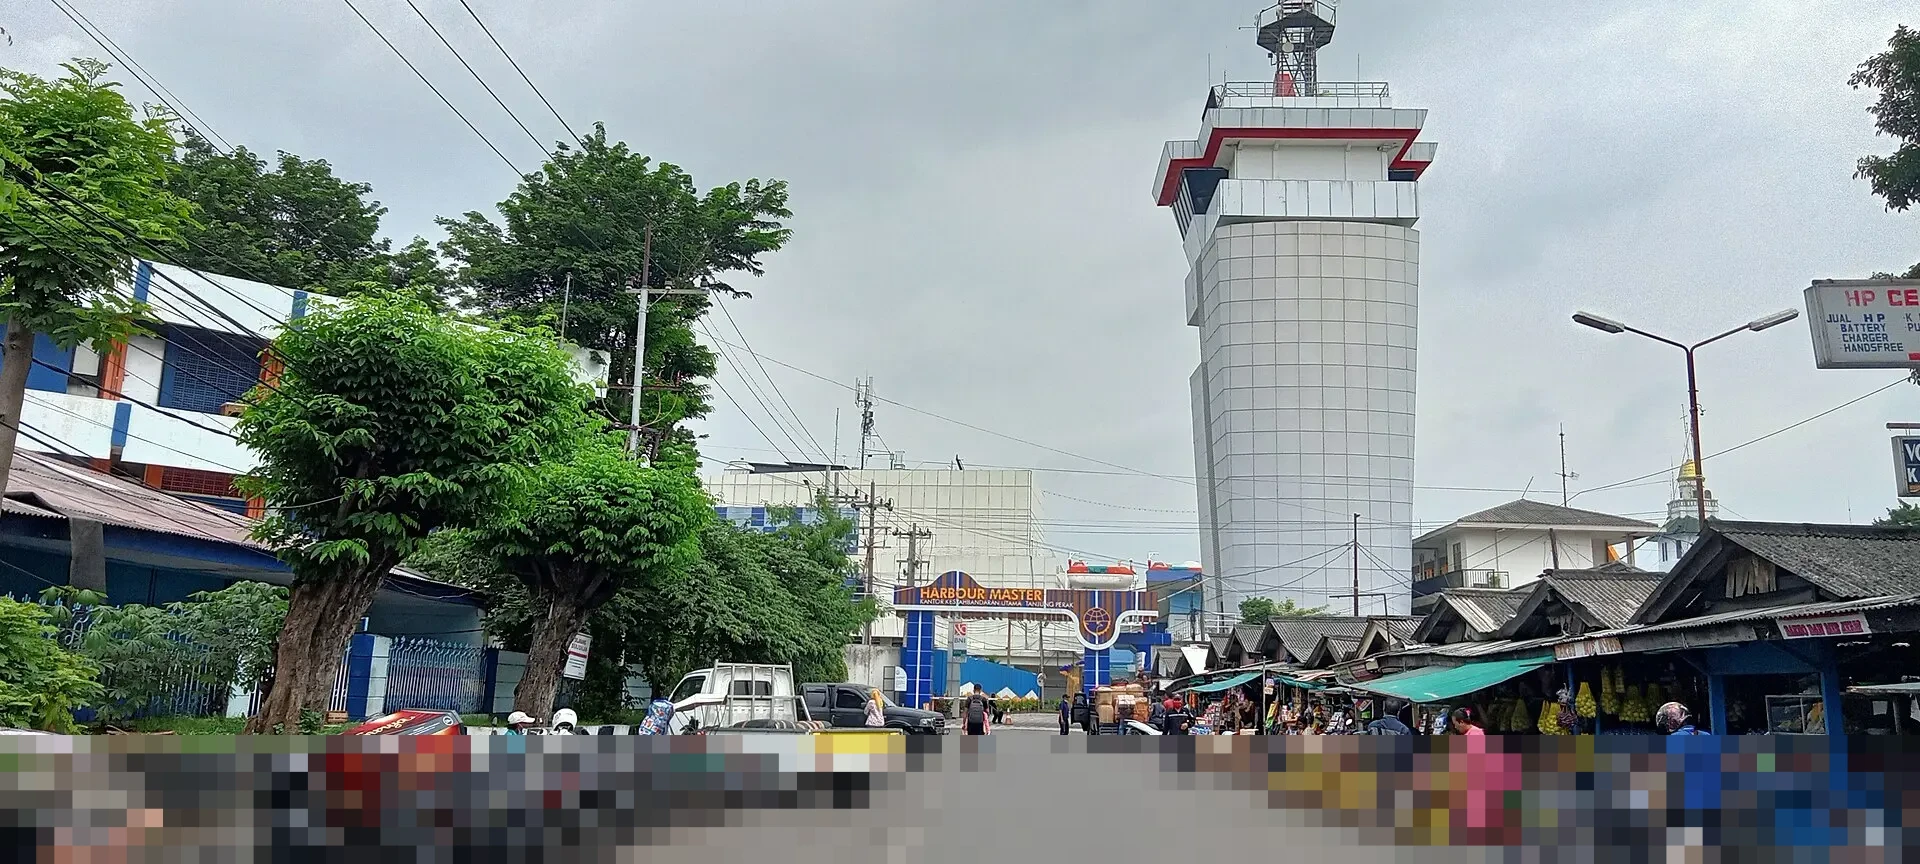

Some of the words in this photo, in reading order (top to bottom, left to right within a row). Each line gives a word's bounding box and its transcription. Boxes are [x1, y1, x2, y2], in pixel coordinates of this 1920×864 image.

[1844, 290, 1876, 306] HP
[1826, 314, 1852, 323] JUAL
[1841, 323, 1886, 333] BATTERY
[1842, 333, 1888, 343] CHARGER
[1844, 343, 1904, 352] HANDSFREE
[920, 587, 985, 600] HARBOUR
[989, 588, 1042, 601] MASTER
